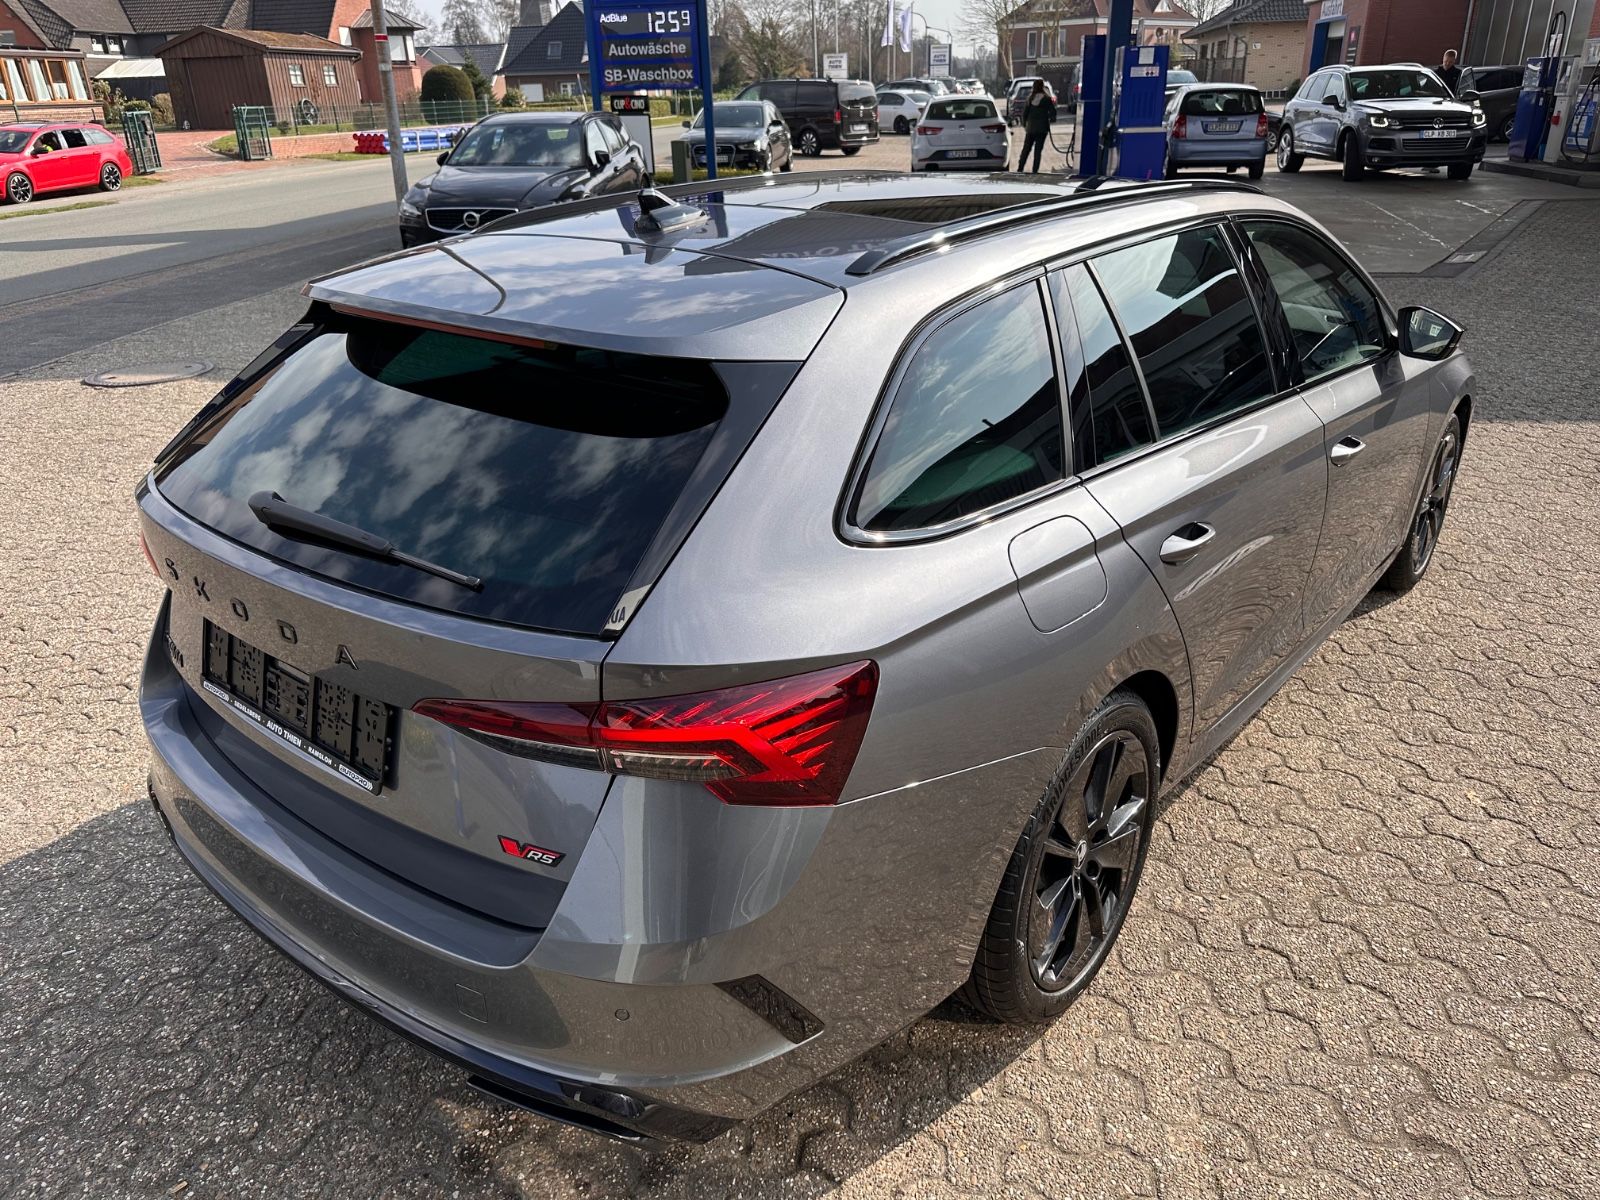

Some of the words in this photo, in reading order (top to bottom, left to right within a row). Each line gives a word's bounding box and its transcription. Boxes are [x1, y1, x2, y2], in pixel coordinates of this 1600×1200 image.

[600, 12, 628, 23] AdBlue
[608, 42, 687, 57] Autowäsche
[604, 68, 694, 83] SB-Waschbox
[164, 557, 360, 671] SKODA
[266, 720, 283, 735] AUTO
[283, 730, 302, 747] THIEN
